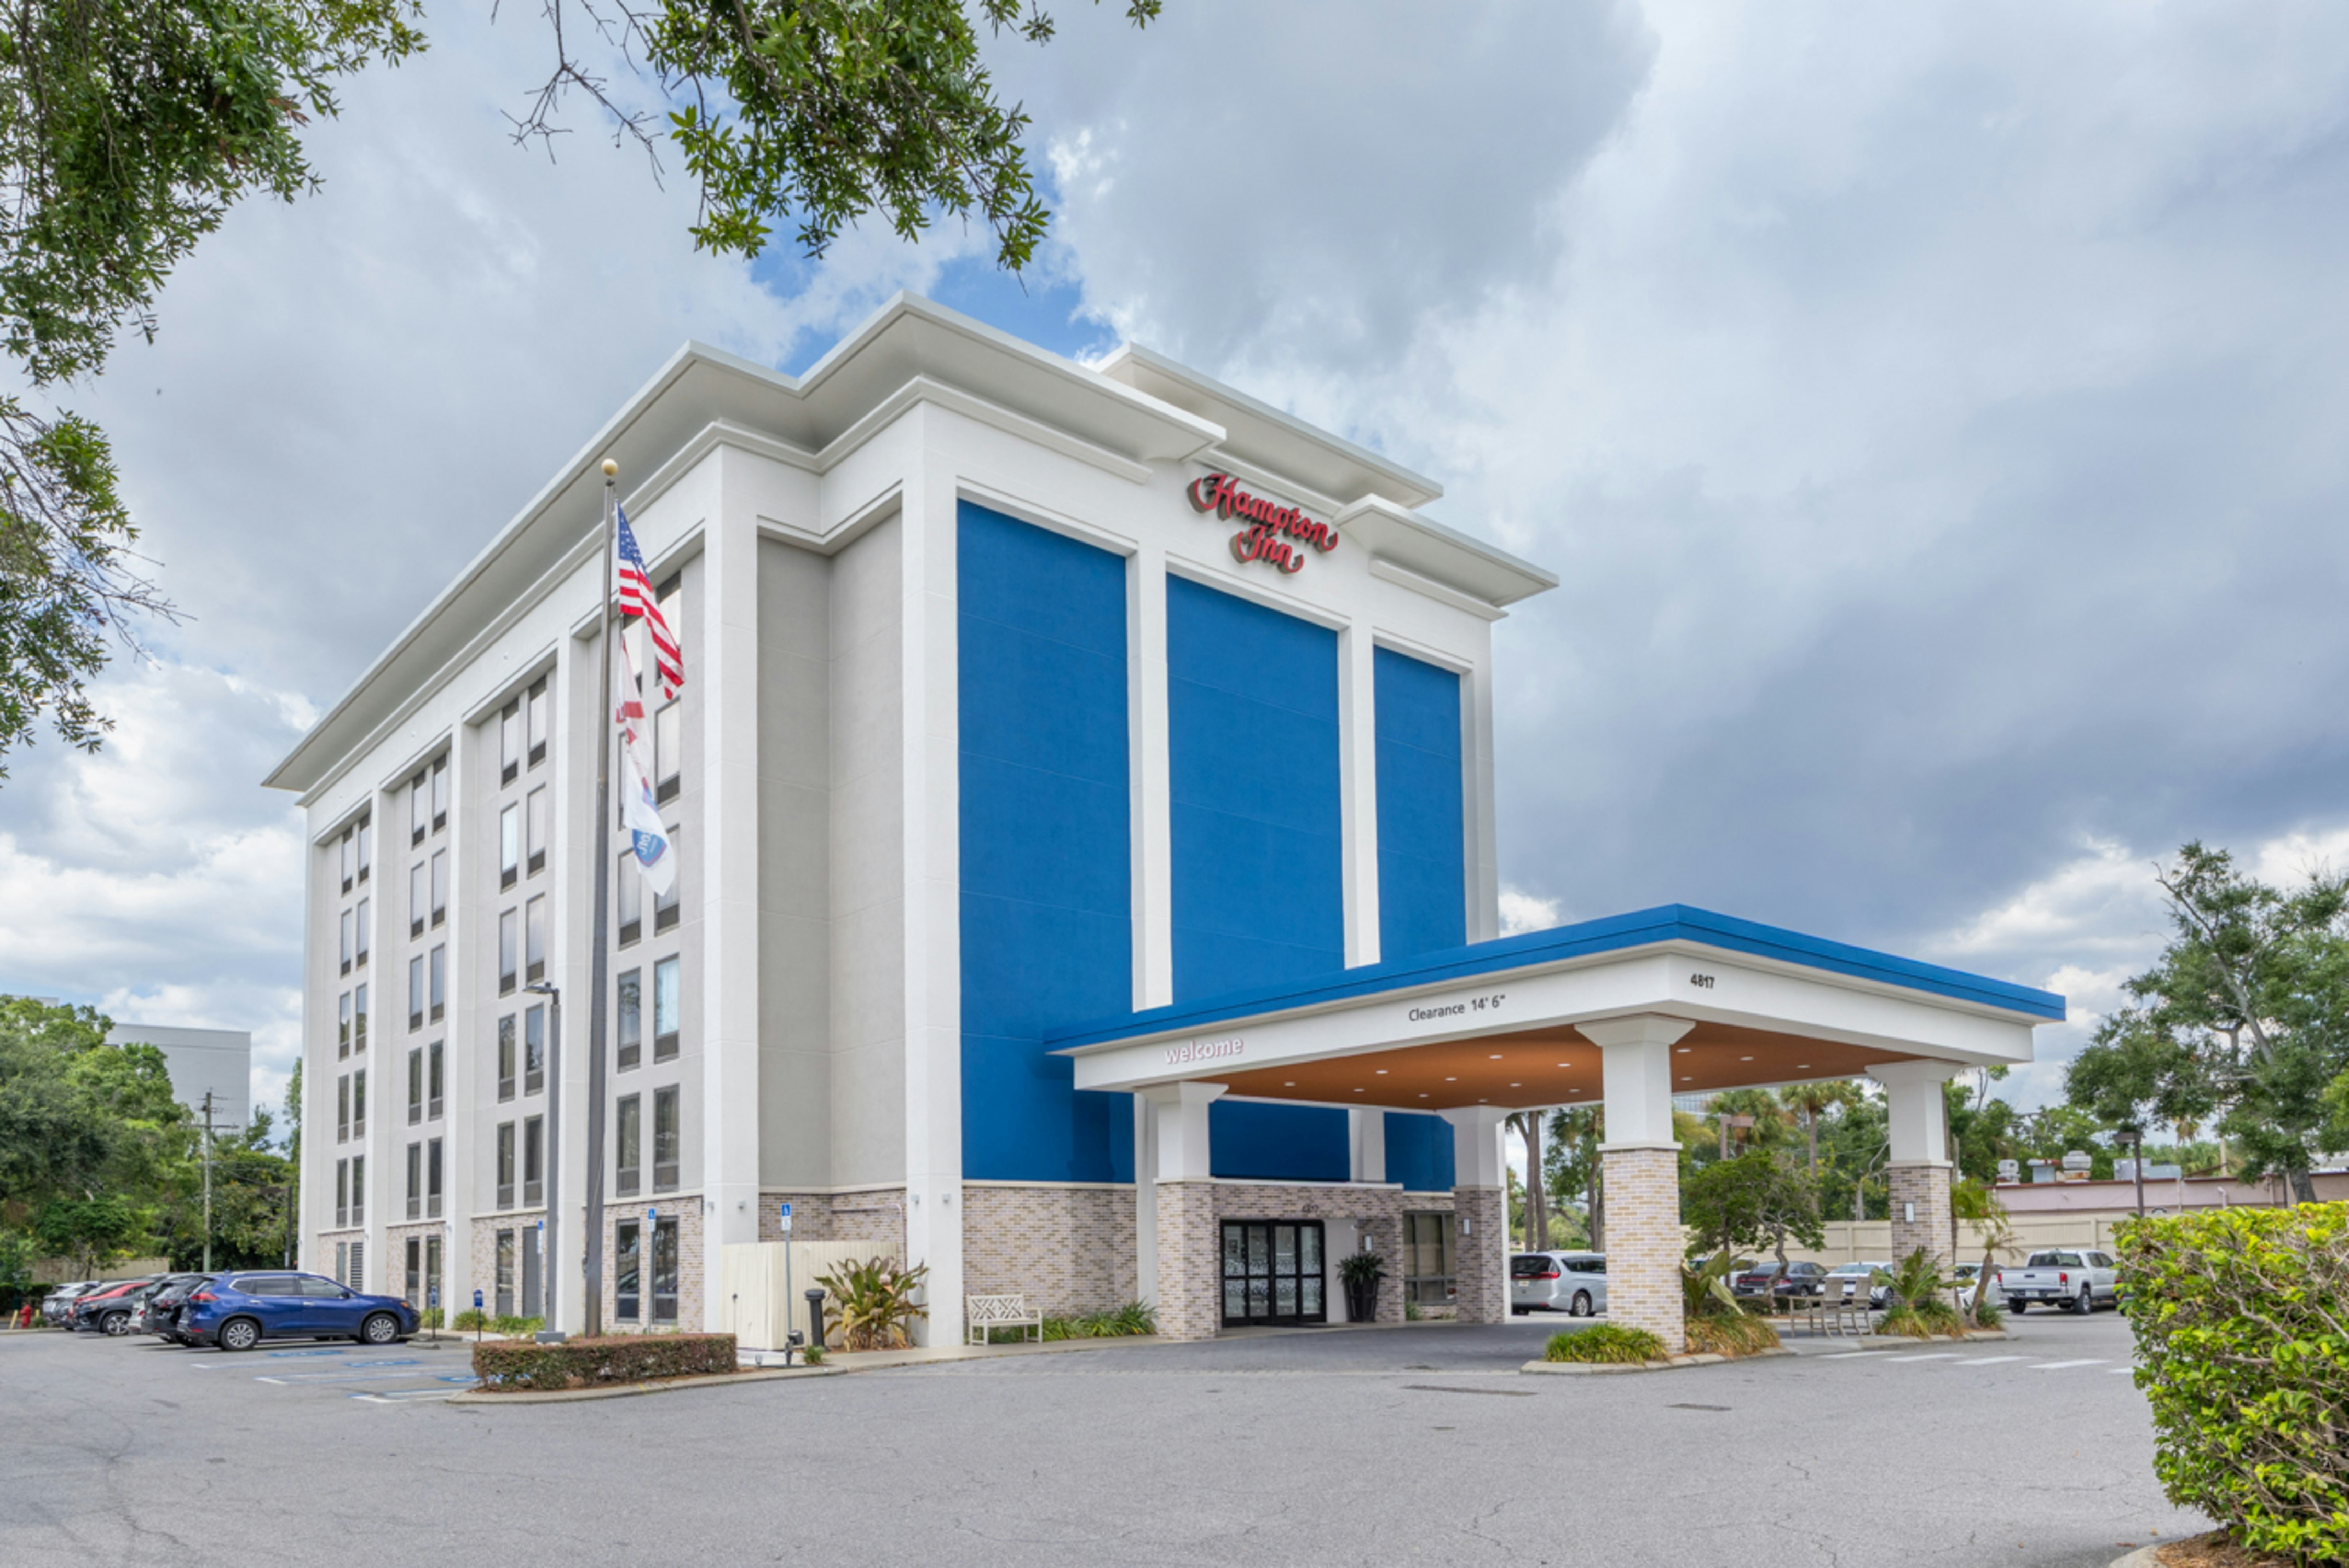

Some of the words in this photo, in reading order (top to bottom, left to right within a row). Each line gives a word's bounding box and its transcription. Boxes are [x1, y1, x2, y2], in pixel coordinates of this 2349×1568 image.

[1192, 472, 1338, 551] Hampton
[1236, 525, 1305, 573] Inn
[1690, 973, 1715, 989] 4817
[1409, 1003, 1465, 1021] Clearance
[1471, 996, 1489, 1011] 14'
[1165, 1037, 1244, 1064] welcome
